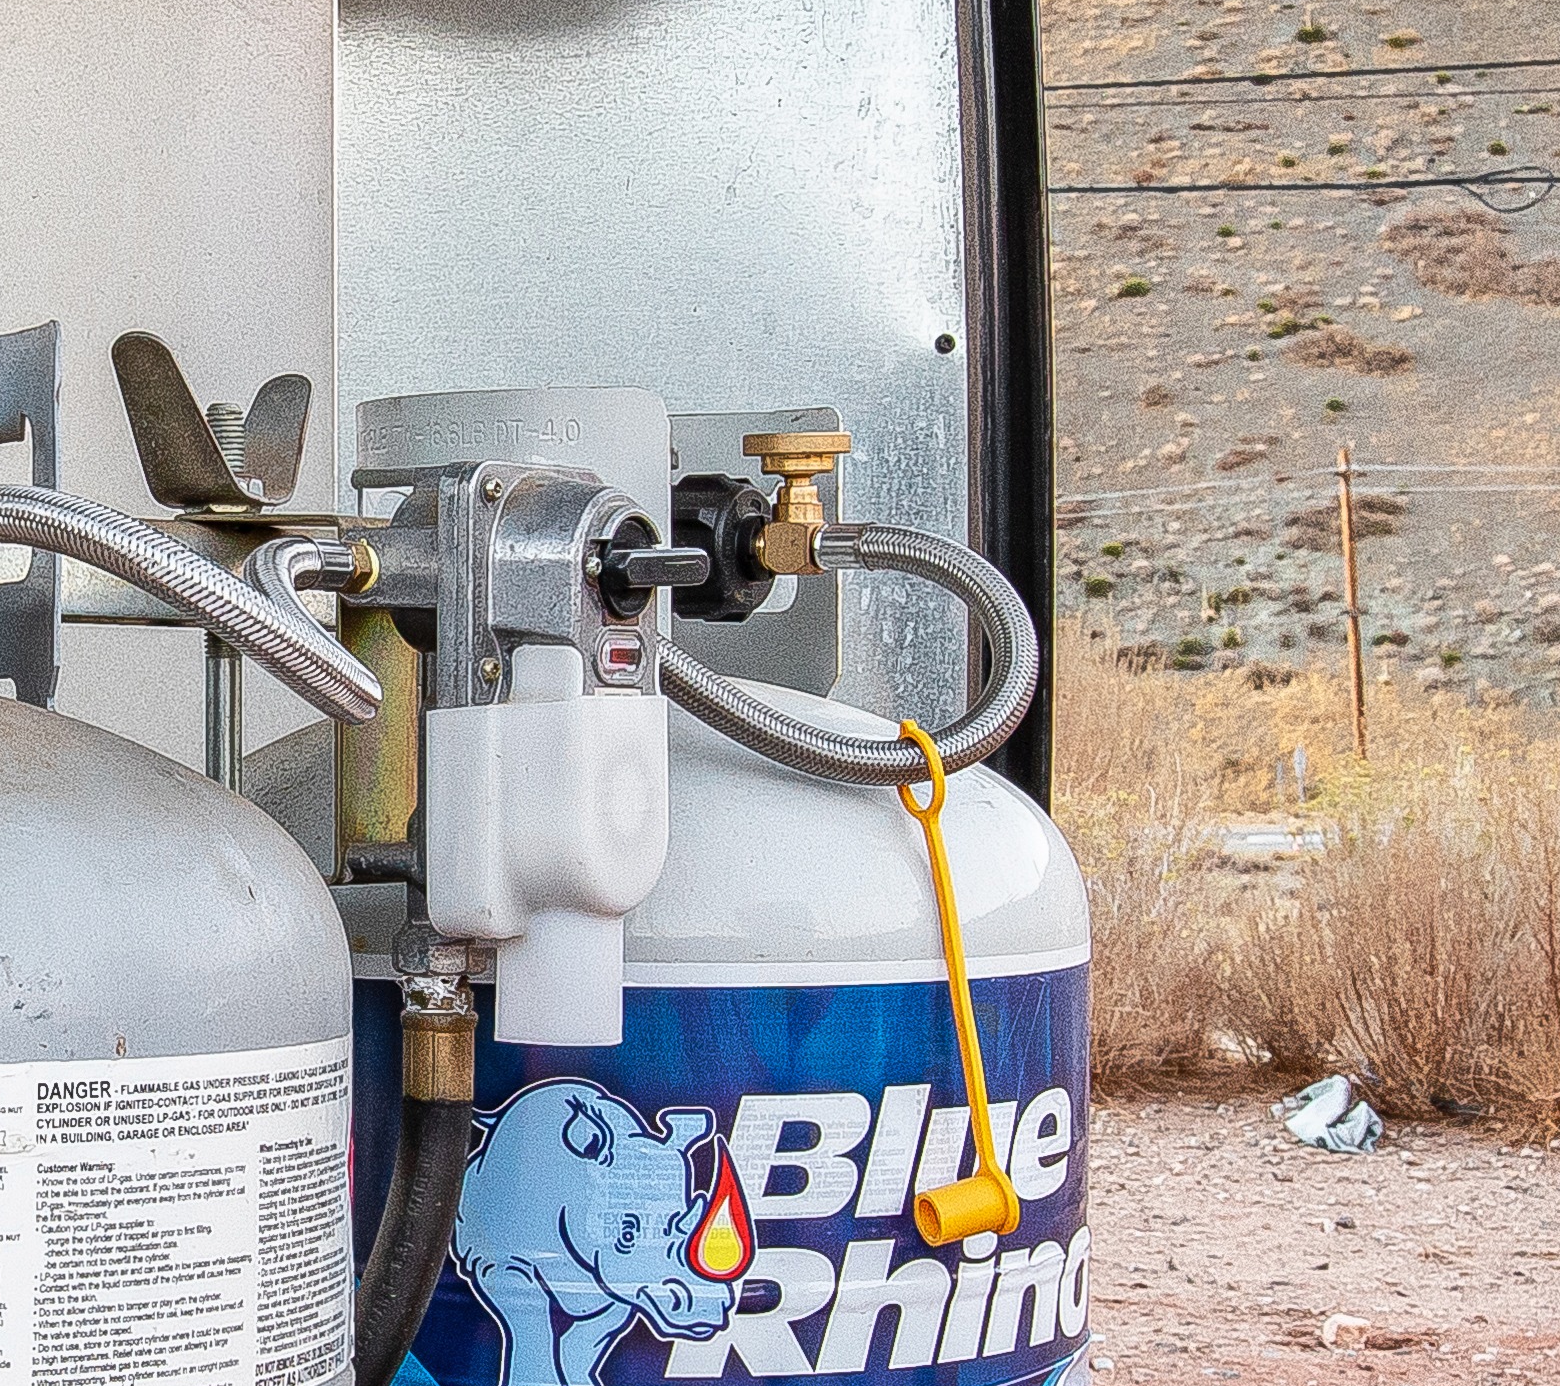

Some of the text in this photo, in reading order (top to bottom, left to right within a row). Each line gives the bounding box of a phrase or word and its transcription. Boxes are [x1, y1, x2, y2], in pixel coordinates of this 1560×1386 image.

[37, 1073, 270, 1100] DANGER FLAMMABLE GAS UNDER PRESSURE
[36, 1095, 199, 1113] EXPLOSION IF IGNITED-CONTACT
[36, 1110, 191, 1129] CYLINDER OR UNUSED LP-GAS
[36, 1134, 47, 1144] IN
[50, 1133, 58, 1144] A
[61, 1131, 115, 1144] BUILDING,
[118, 1128, 159, 1141] GARAGE
[162, 1126, 176, 1138] OR
[178, 1123, 224, 1137] ENCLOSED
[732, 1084, 1071, 1220] Blue
[665, 1225, 1090, 1379] Rhino
